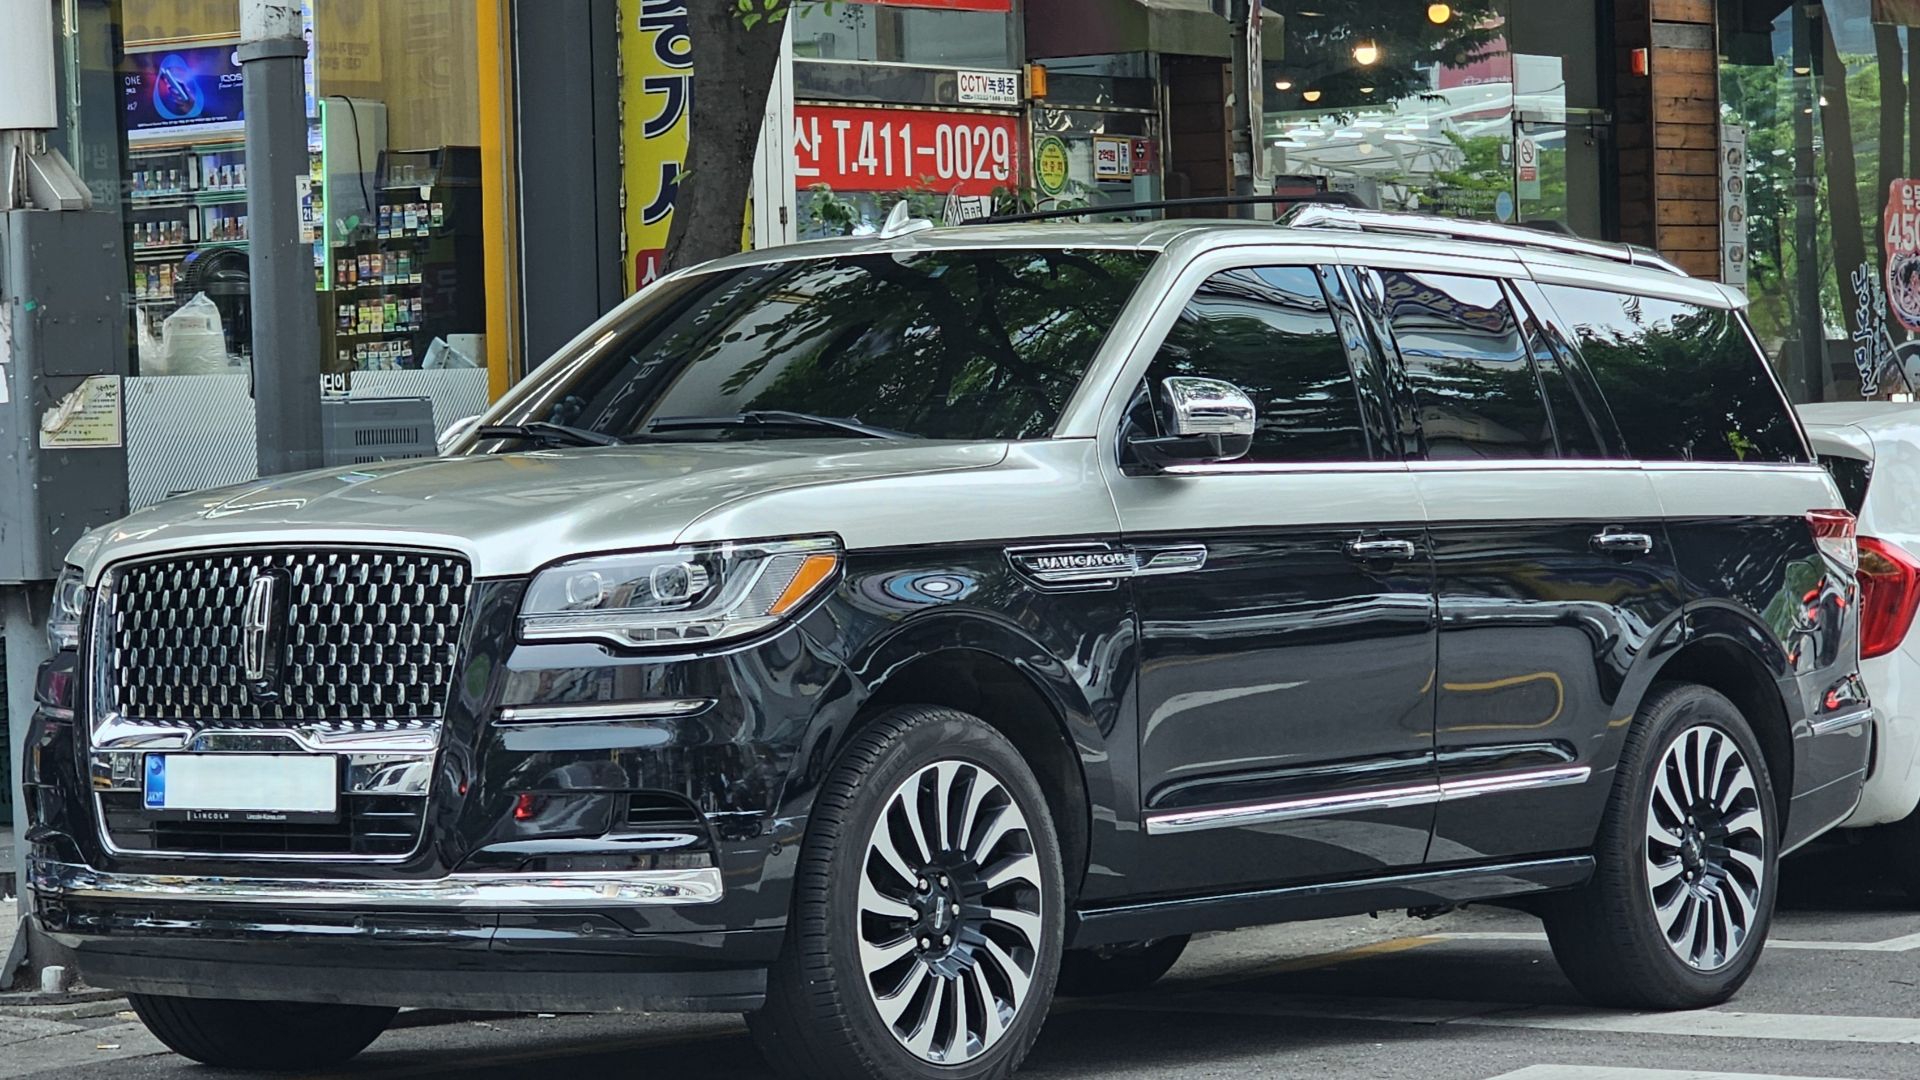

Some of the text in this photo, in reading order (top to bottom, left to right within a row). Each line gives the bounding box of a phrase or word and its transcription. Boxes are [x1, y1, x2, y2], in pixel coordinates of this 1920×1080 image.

[832, 120, 1009, 181] T.411-0029
[1037, 553, 1124, 570] NAVIGATOR
[193, 812, 230, 820] LINCOLN
